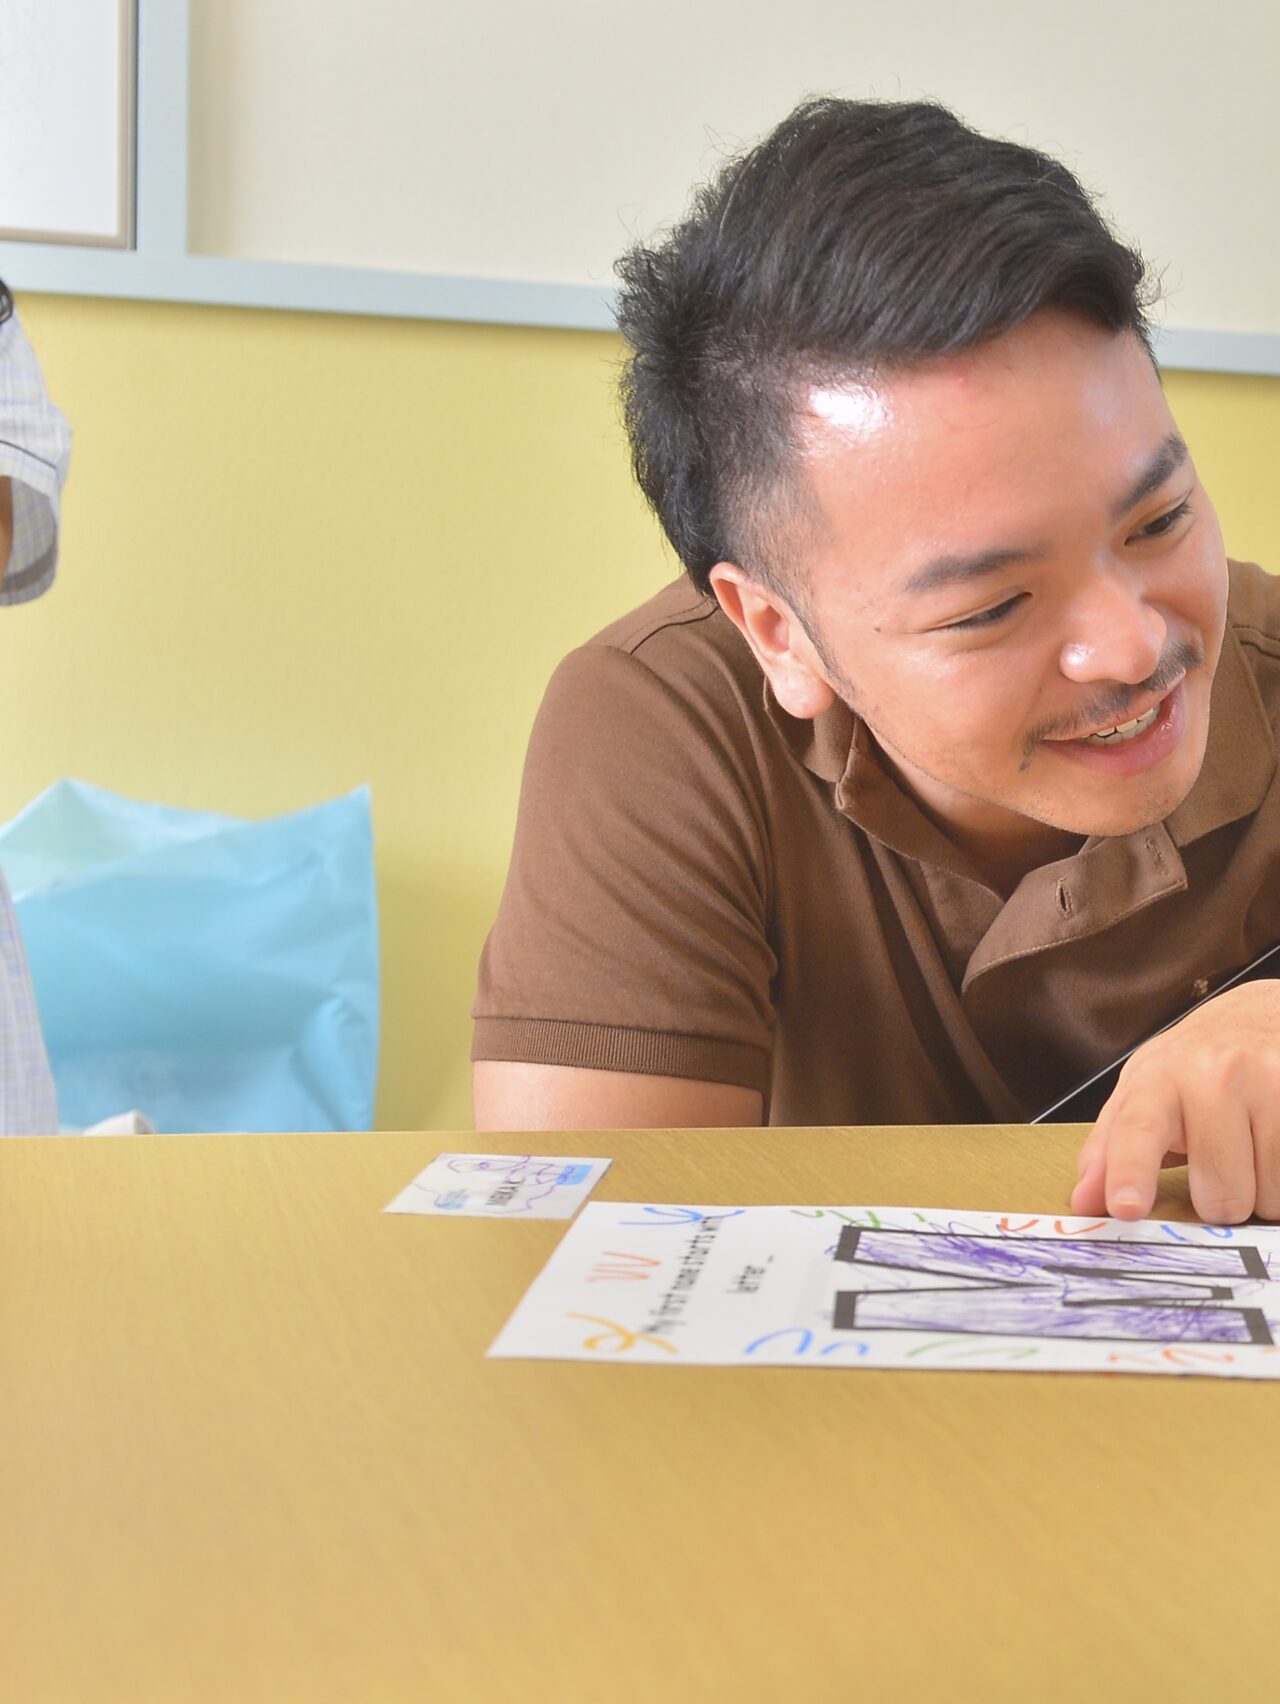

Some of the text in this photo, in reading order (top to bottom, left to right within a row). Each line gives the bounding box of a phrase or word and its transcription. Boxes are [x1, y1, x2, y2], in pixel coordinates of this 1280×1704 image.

[678, 1234, 716, 1266] starts
[669, 1267, 701, 1291] name
[726, 1264, 766, 1293] letter
[833, 1225, 1274, 1345] M
[649, 1293, 689, 1315] first
[642, 1319, 688, 1334] My
